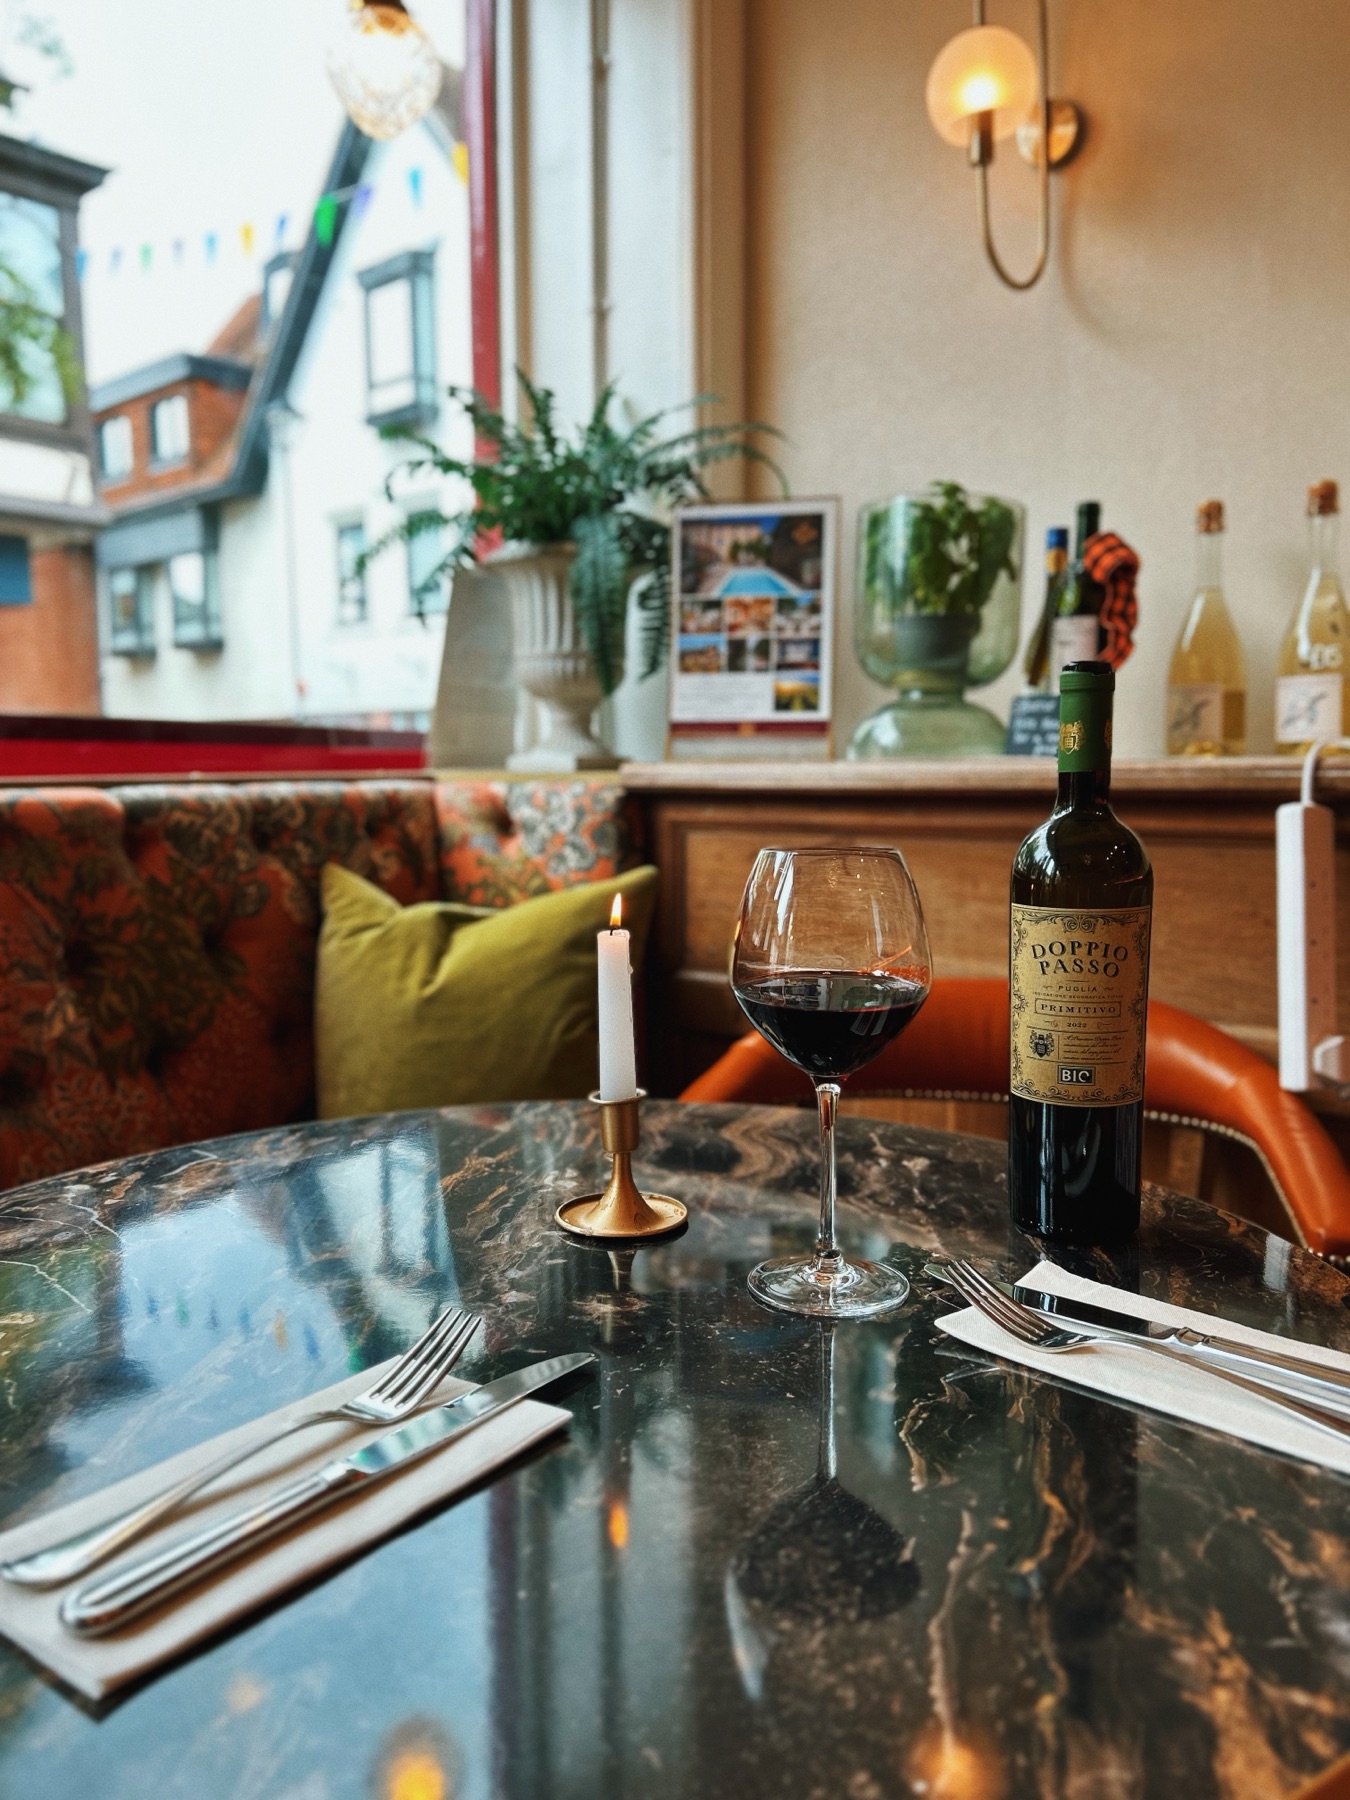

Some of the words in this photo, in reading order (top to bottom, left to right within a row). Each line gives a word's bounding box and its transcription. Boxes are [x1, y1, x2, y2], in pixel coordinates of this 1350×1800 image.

[1031, 940, 1129, 962] DOPPIO
[1039, 958, 1120, 978] PASSO
[1058, 985, 1098, 993] PUGLIA
[1040, 1004, 1117, 1014] PRIMITIVO
